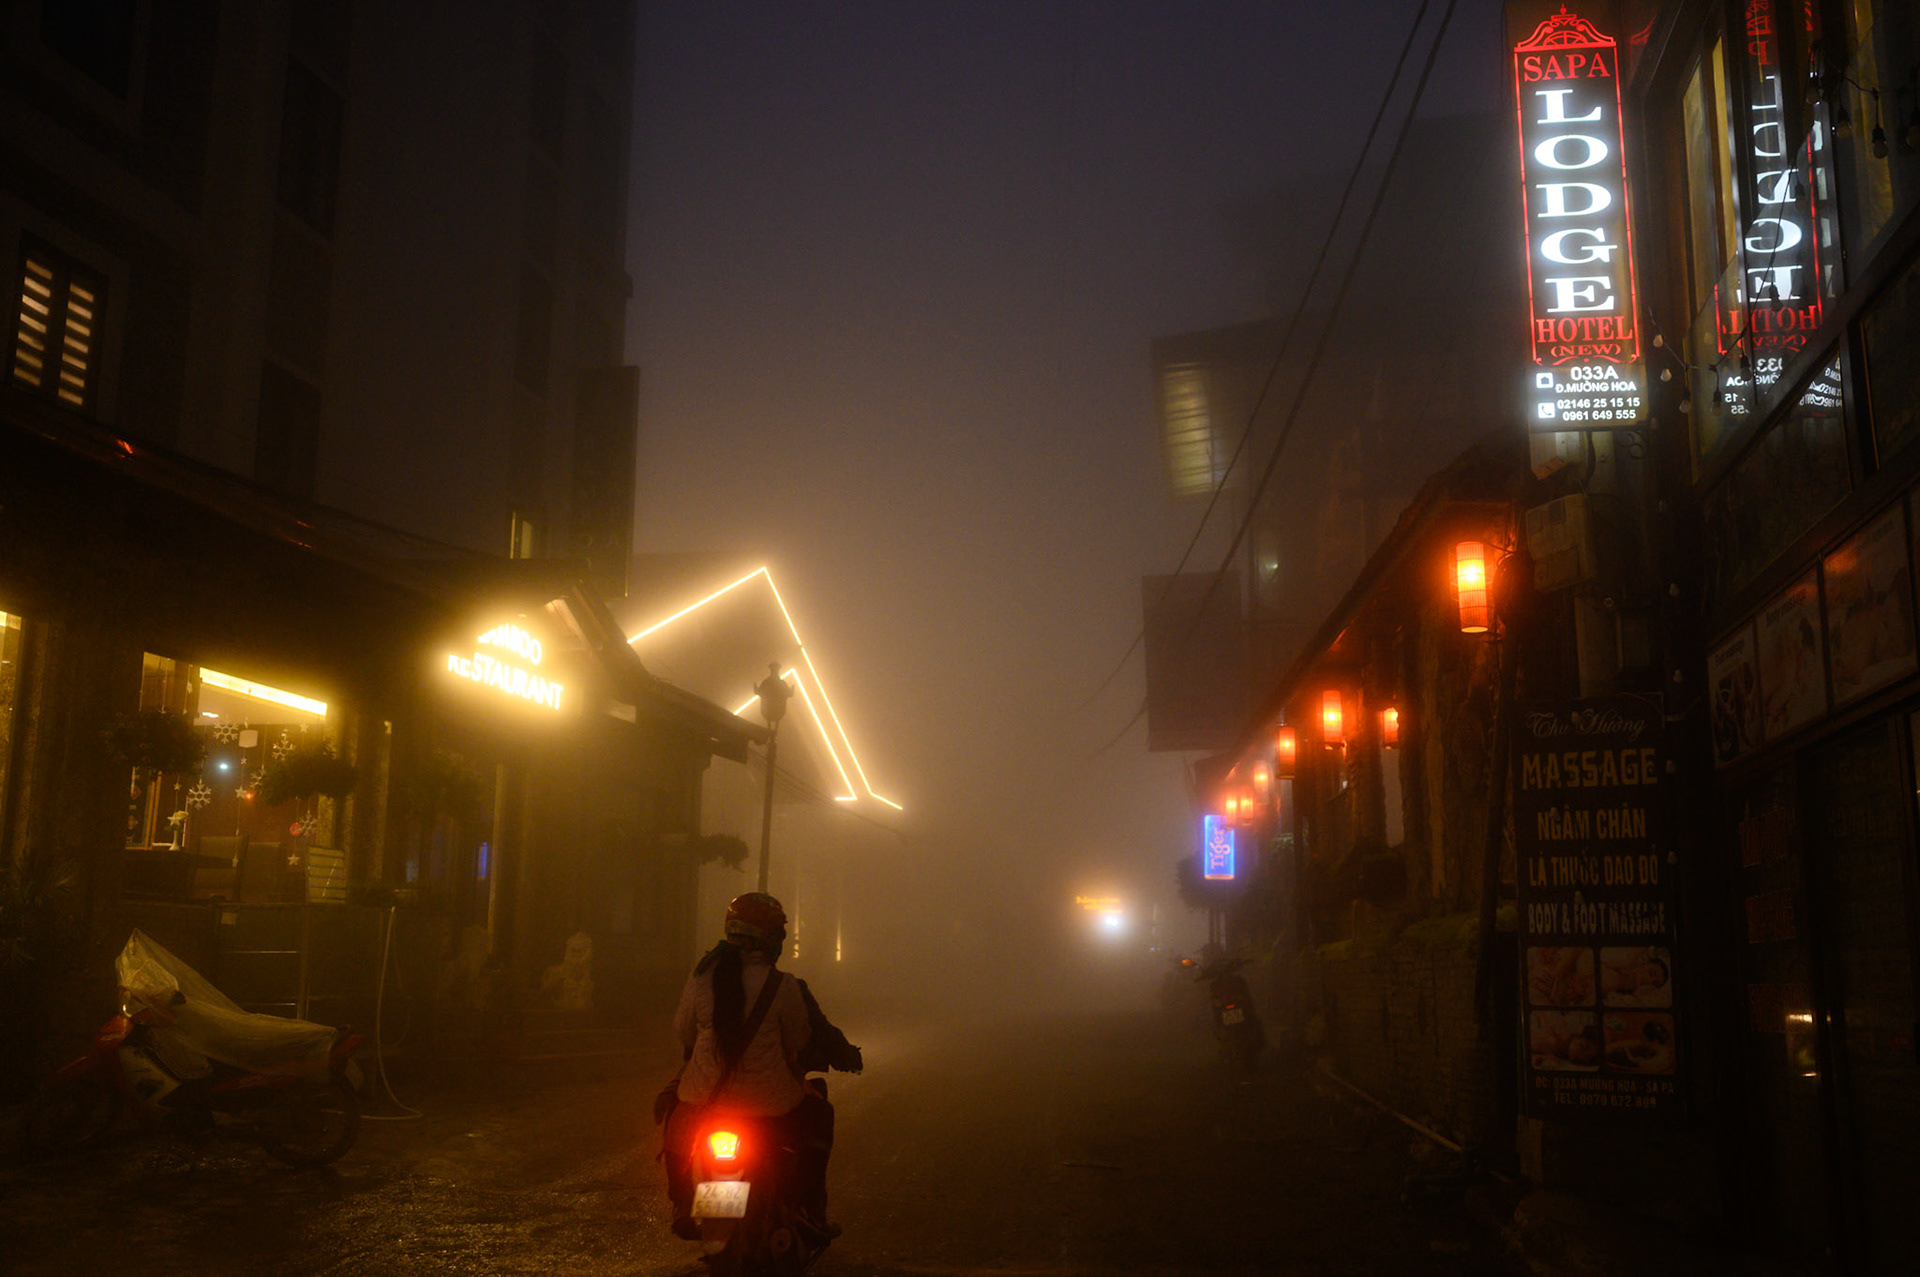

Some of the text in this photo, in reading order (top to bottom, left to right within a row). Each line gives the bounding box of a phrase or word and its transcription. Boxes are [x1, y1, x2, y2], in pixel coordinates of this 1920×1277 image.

[1523, 52, 1611, 82] SAPA
[1534, 88, 1618, 313] LODGE
[1536, 315, 1633, 343] HOTEL
[1550, 343, 1621, 358] (NEW)
[1570, 365, 1619, 381] 033A
[1611, 381, 1637, 392] HOA
[1557, 397, 1641, 410] 02146 25 15 15
[1562, 409, 1637, 421] 0961 649 555
[447, 652, 564, 710] RESTAURANT
[1522, 747, 1658, 790] MASSAGE
[1209, 827, 1231, 869] Tiger
[1604, 855, 1634, 886] DAO
[1528, 902, 1558, 934] BODY
[1562, 902, 1571, 934] &
[1574, 901, 1606, 934] FOOT
